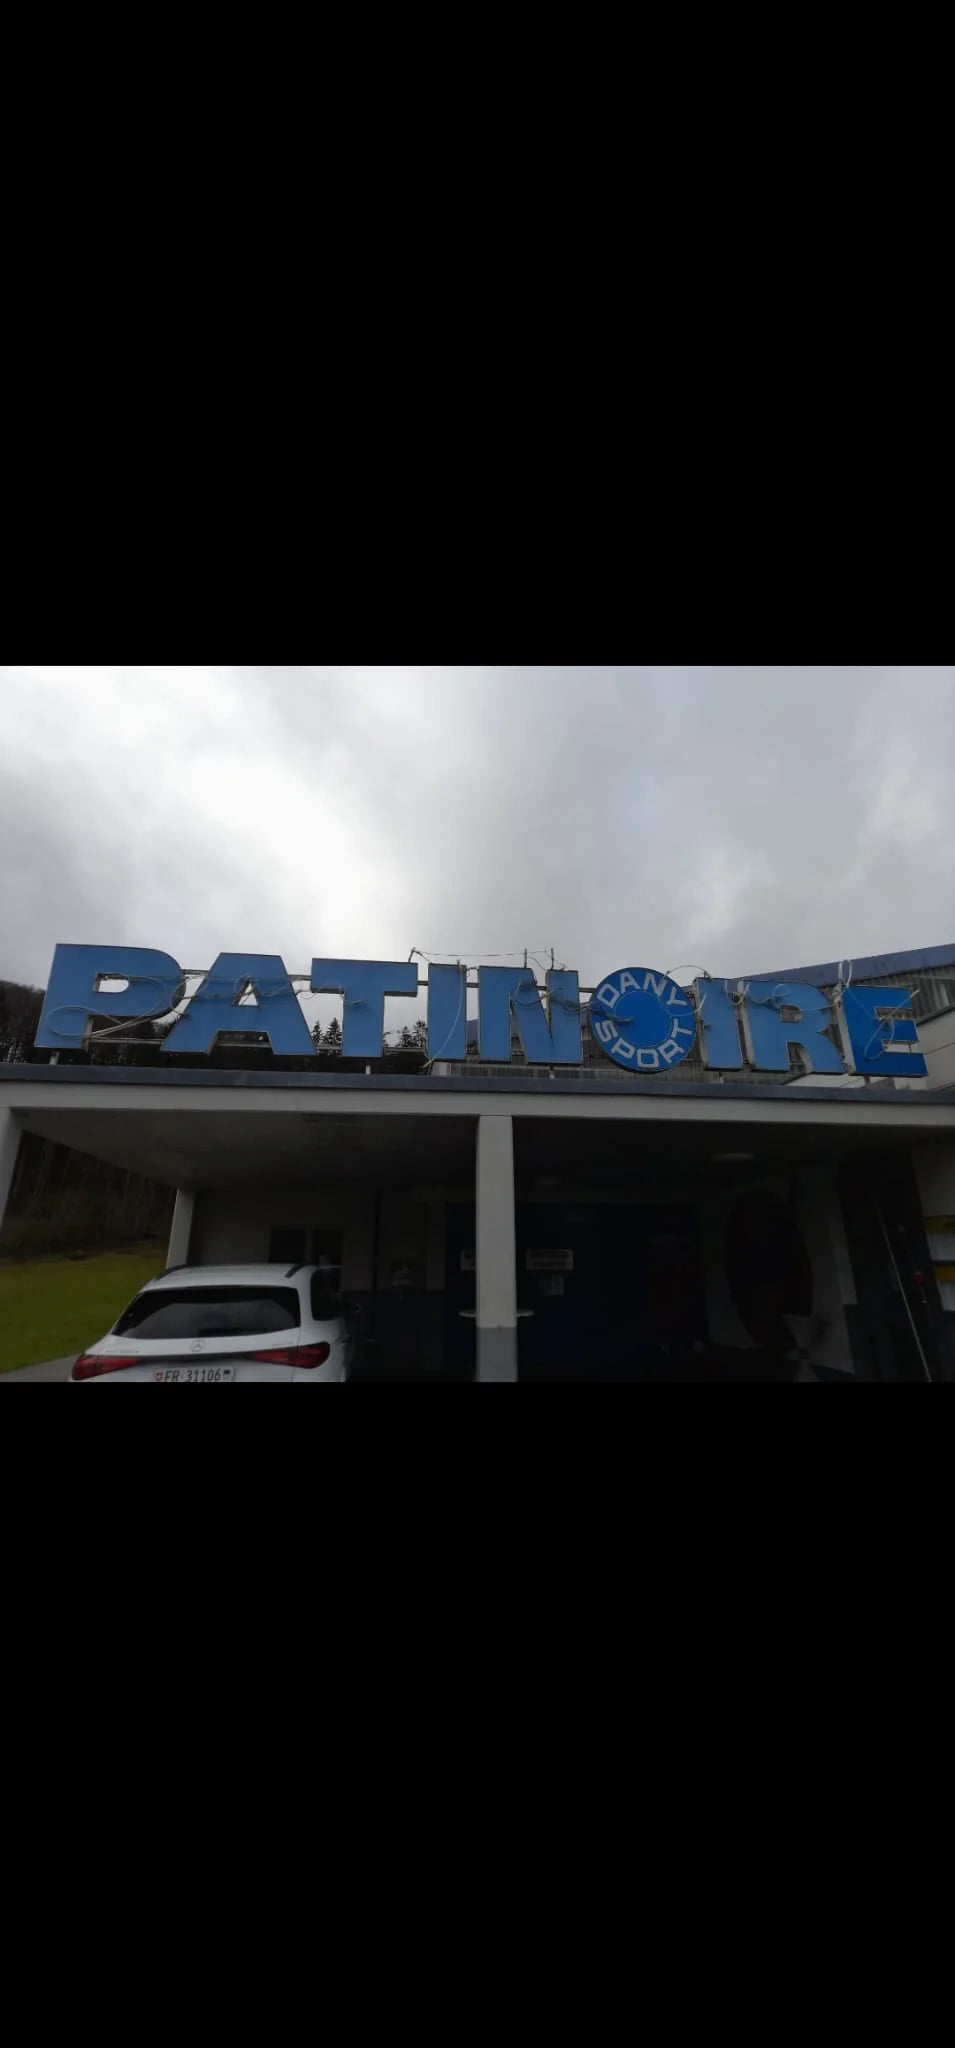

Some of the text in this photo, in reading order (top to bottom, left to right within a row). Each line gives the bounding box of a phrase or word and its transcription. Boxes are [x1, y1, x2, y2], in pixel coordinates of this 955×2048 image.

[597, 971, 688, 1009] DANY
[595, 1018, 693, 1069] SPORT
[186, 1368, 222, 1382] 31106
